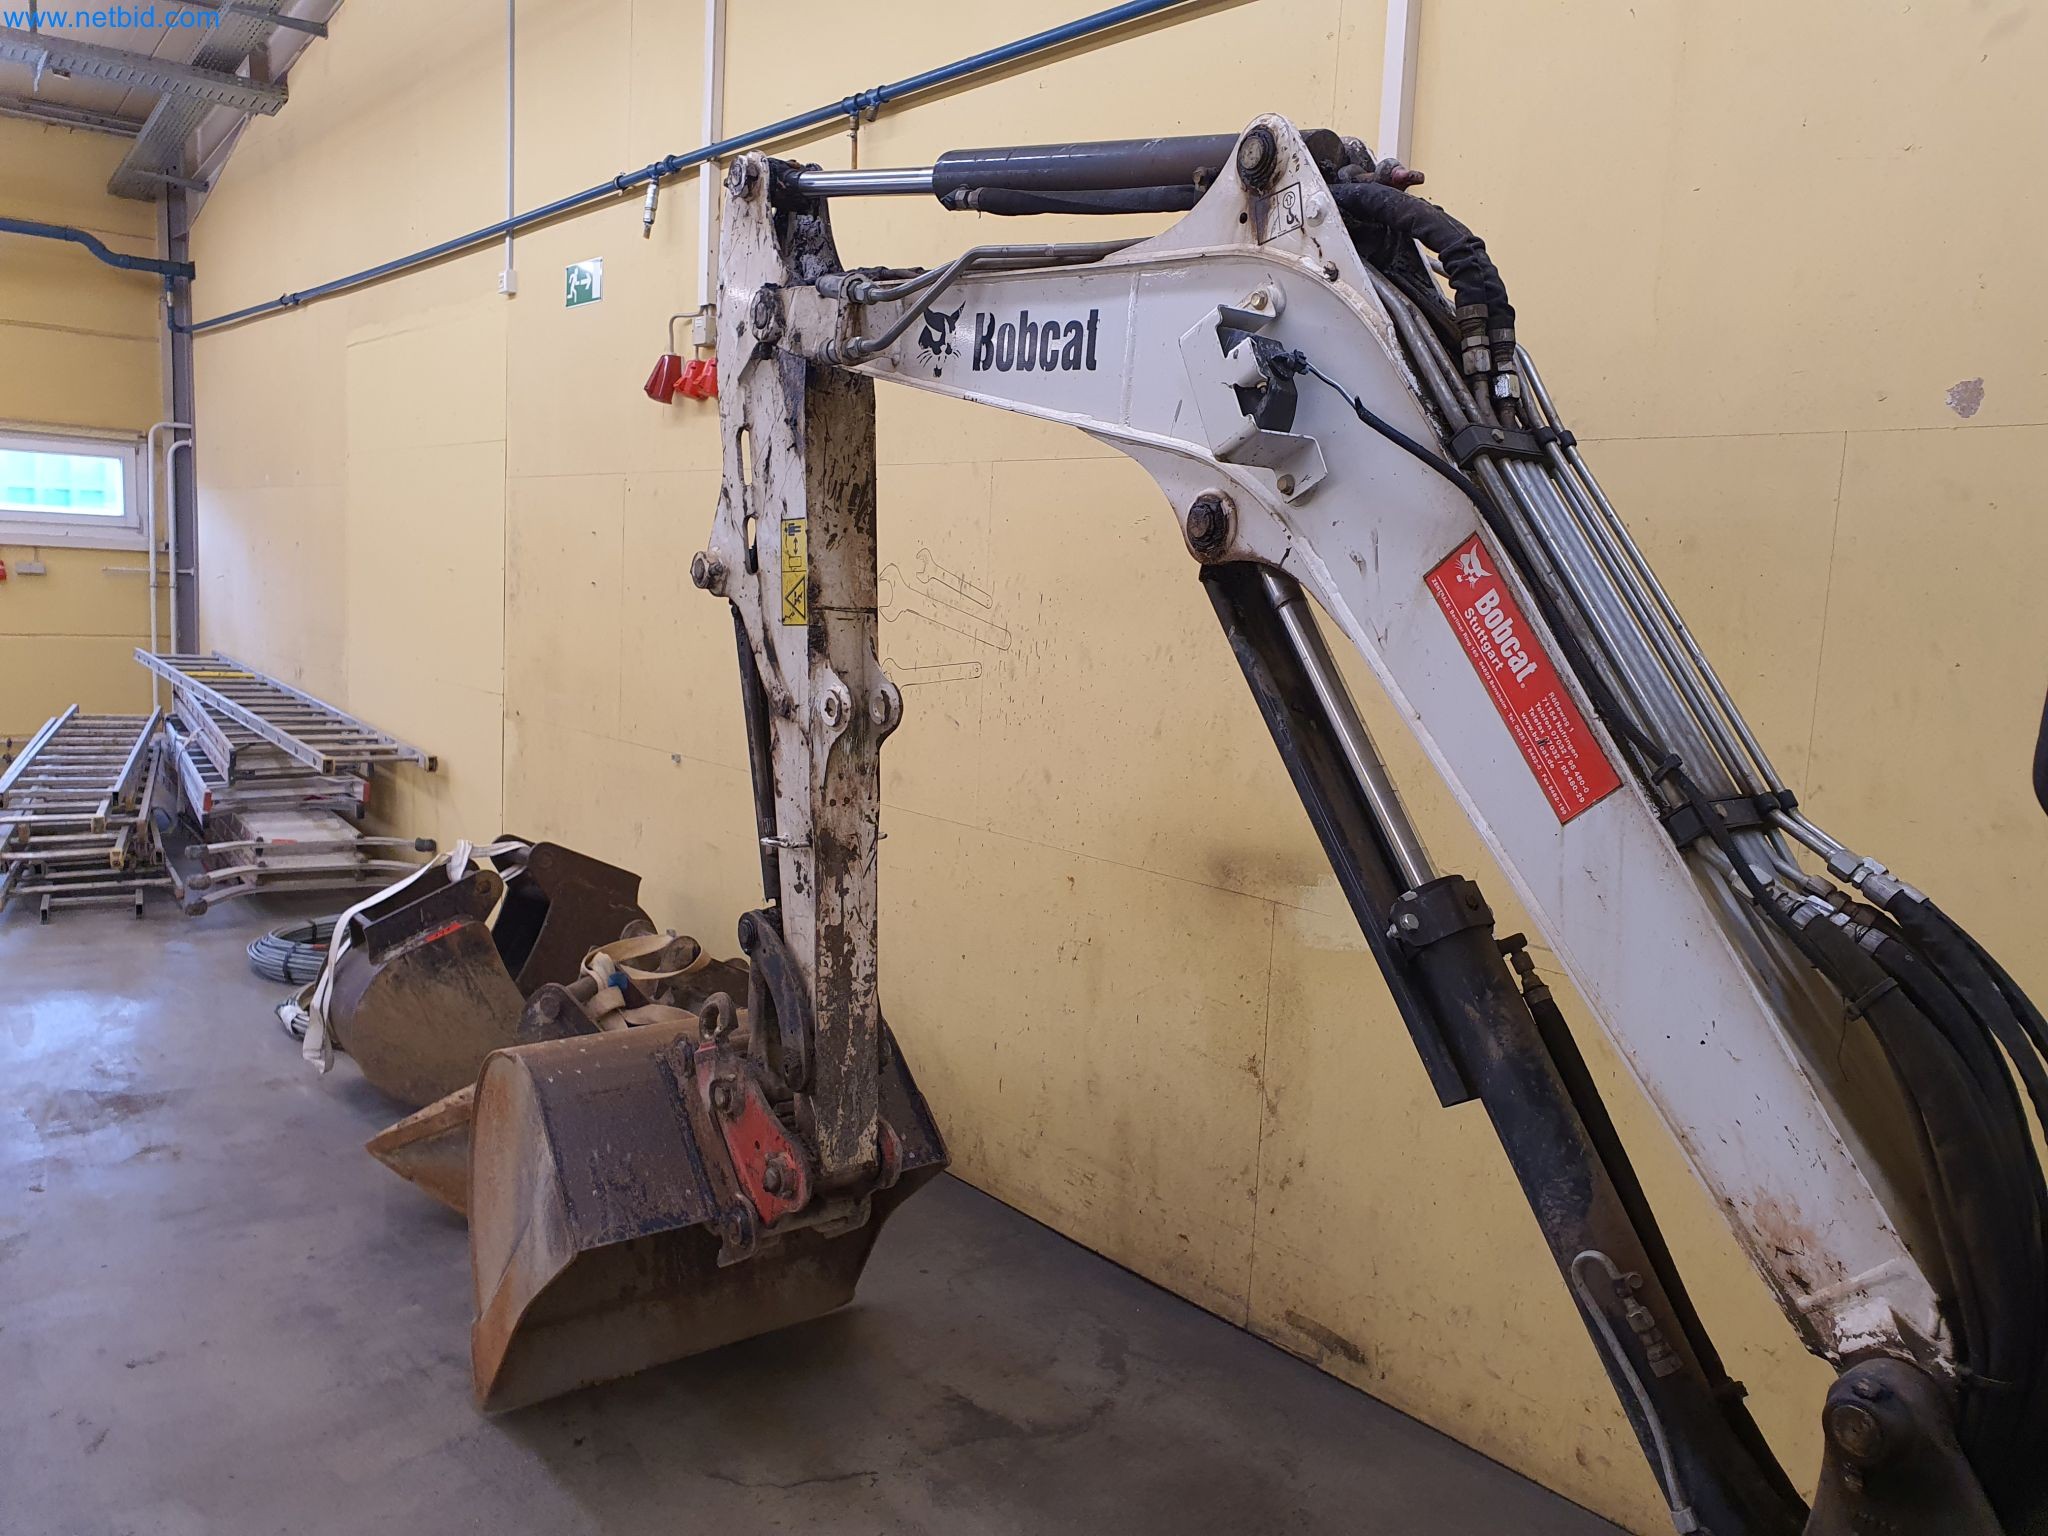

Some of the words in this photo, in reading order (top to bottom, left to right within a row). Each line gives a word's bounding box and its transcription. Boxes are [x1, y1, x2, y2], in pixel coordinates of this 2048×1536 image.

[972, 309, 1100, 372] Bobcat
[1450, 609, 1464, 632] Berliner
[1462, 632, 1472, 646] Ring
[1464, 608, 1504, 671] Stuttgart
[1474, 588, 1537, 683] Bobcat
[1521, 712, 1554, 768] www.bocat.de
[1528, 706, 1545, 734] Telefax
[1568, 777, 1585, 803] 480-29
[1535, 702, 1552, 730] Telefon
[1551, 730, 1567, 754] 07032
[1574, 772, 1589, 793] 480-0
[1555, 721, 1579, 758] Nufringen
